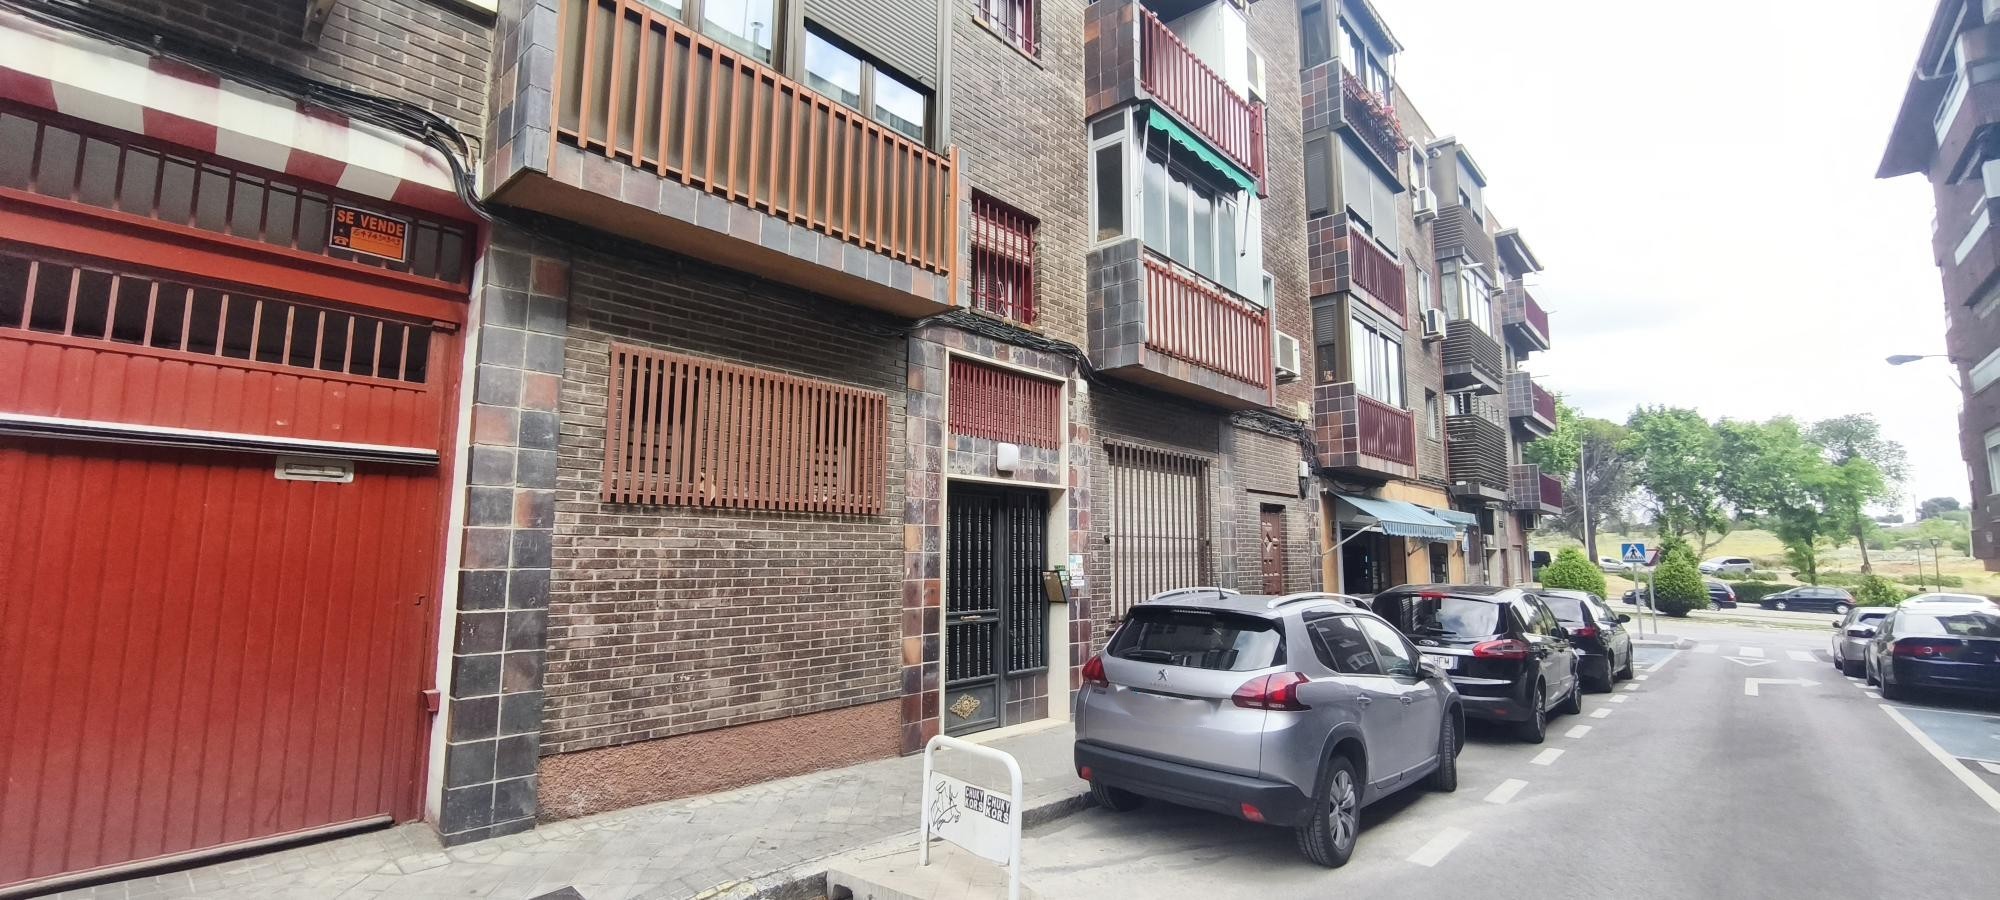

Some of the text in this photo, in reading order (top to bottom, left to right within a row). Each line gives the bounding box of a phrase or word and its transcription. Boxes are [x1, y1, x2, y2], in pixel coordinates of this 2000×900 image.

[337, 209, 404, 236] SE VENDE
[965, 787, 984, 801] CHUKY
[965, 799, 984, 812] KORS
[987, 795, 1010, 812] CHUKY
[985, 805, 1009, 823] KORS
